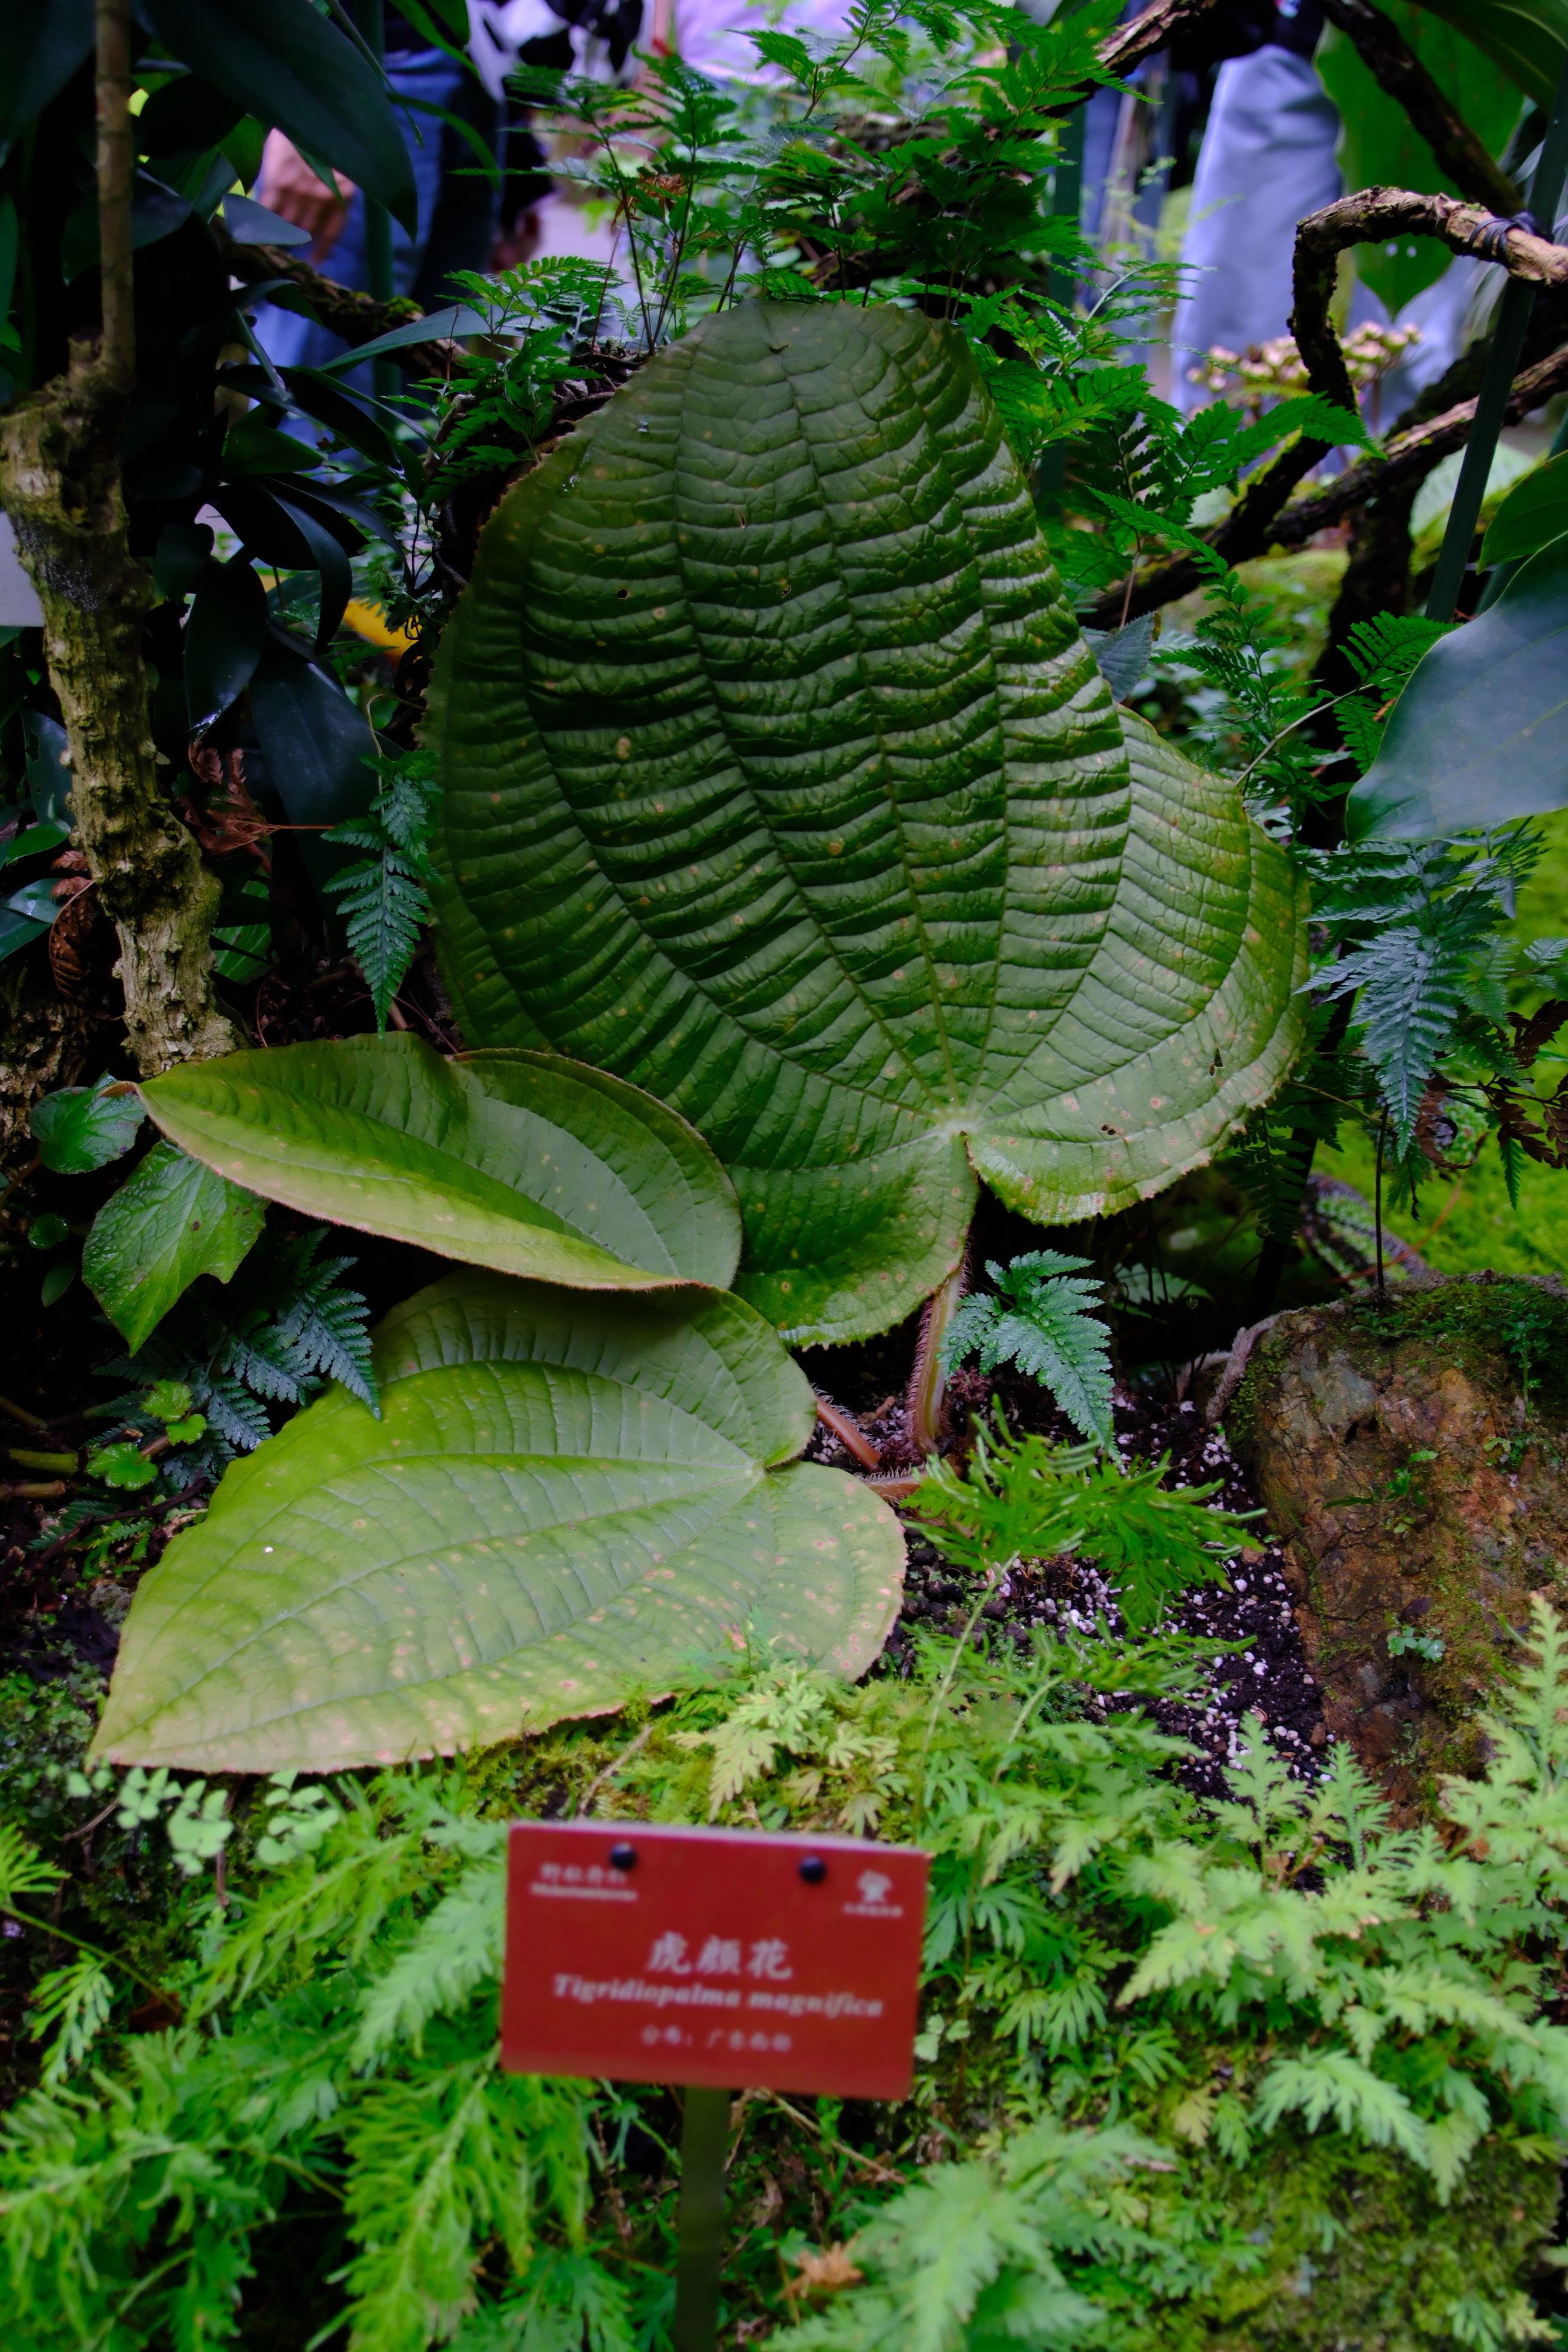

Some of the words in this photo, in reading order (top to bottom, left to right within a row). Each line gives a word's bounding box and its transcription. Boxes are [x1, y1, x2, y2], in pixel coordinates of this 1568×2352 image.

[647, 1931, 793, 1981] 虎颜花
[554, 1973, 742, 2008] Tigridiopalma
[746, 1991, 883, 2019] magnifica
